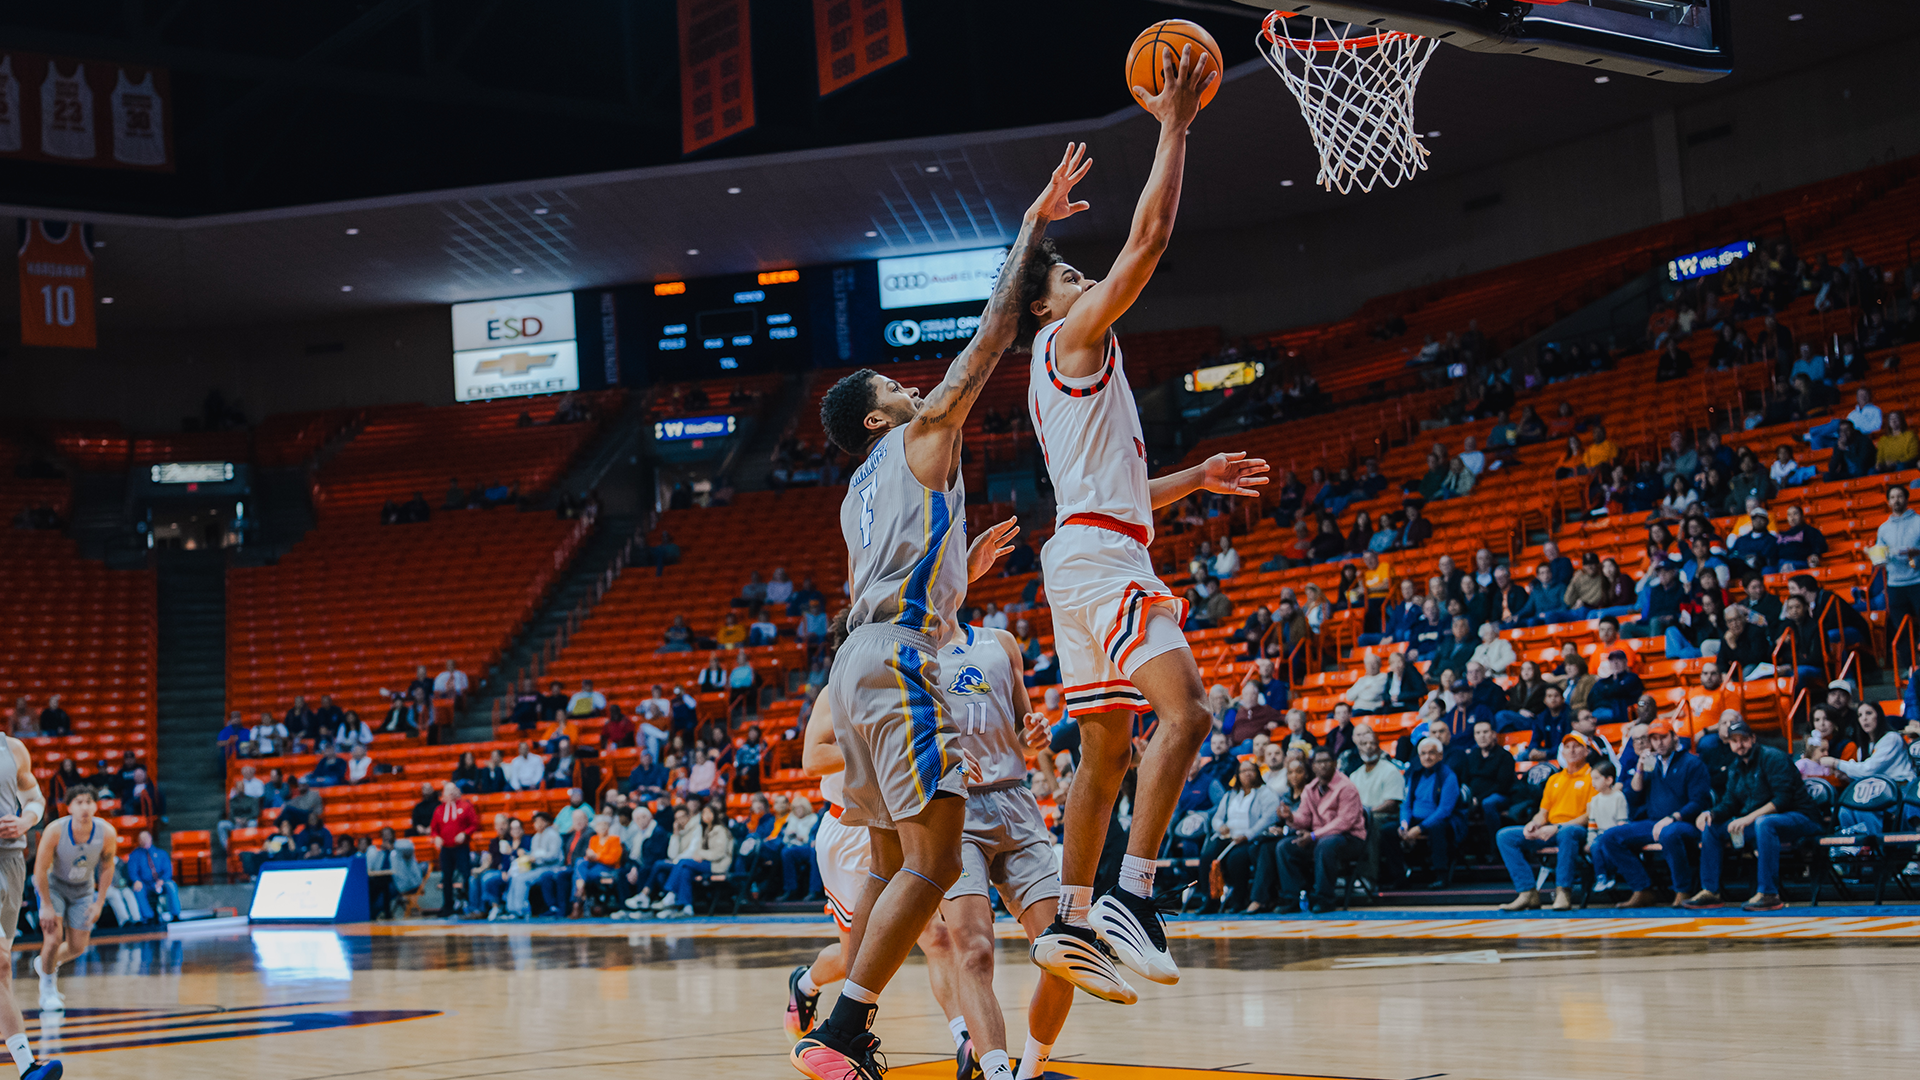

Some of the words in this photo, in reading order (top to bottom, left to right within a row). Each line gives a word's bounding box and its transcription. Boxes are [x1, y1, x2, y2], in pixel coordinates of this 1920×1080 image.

[931, 273, 958, 284] Audi
[41, 284, 76, 327] 10
[487, 317, 543, 341] ESD
[467, 379, 566, 399] CHEVROLET
[965, 702, 987, 736] 11
